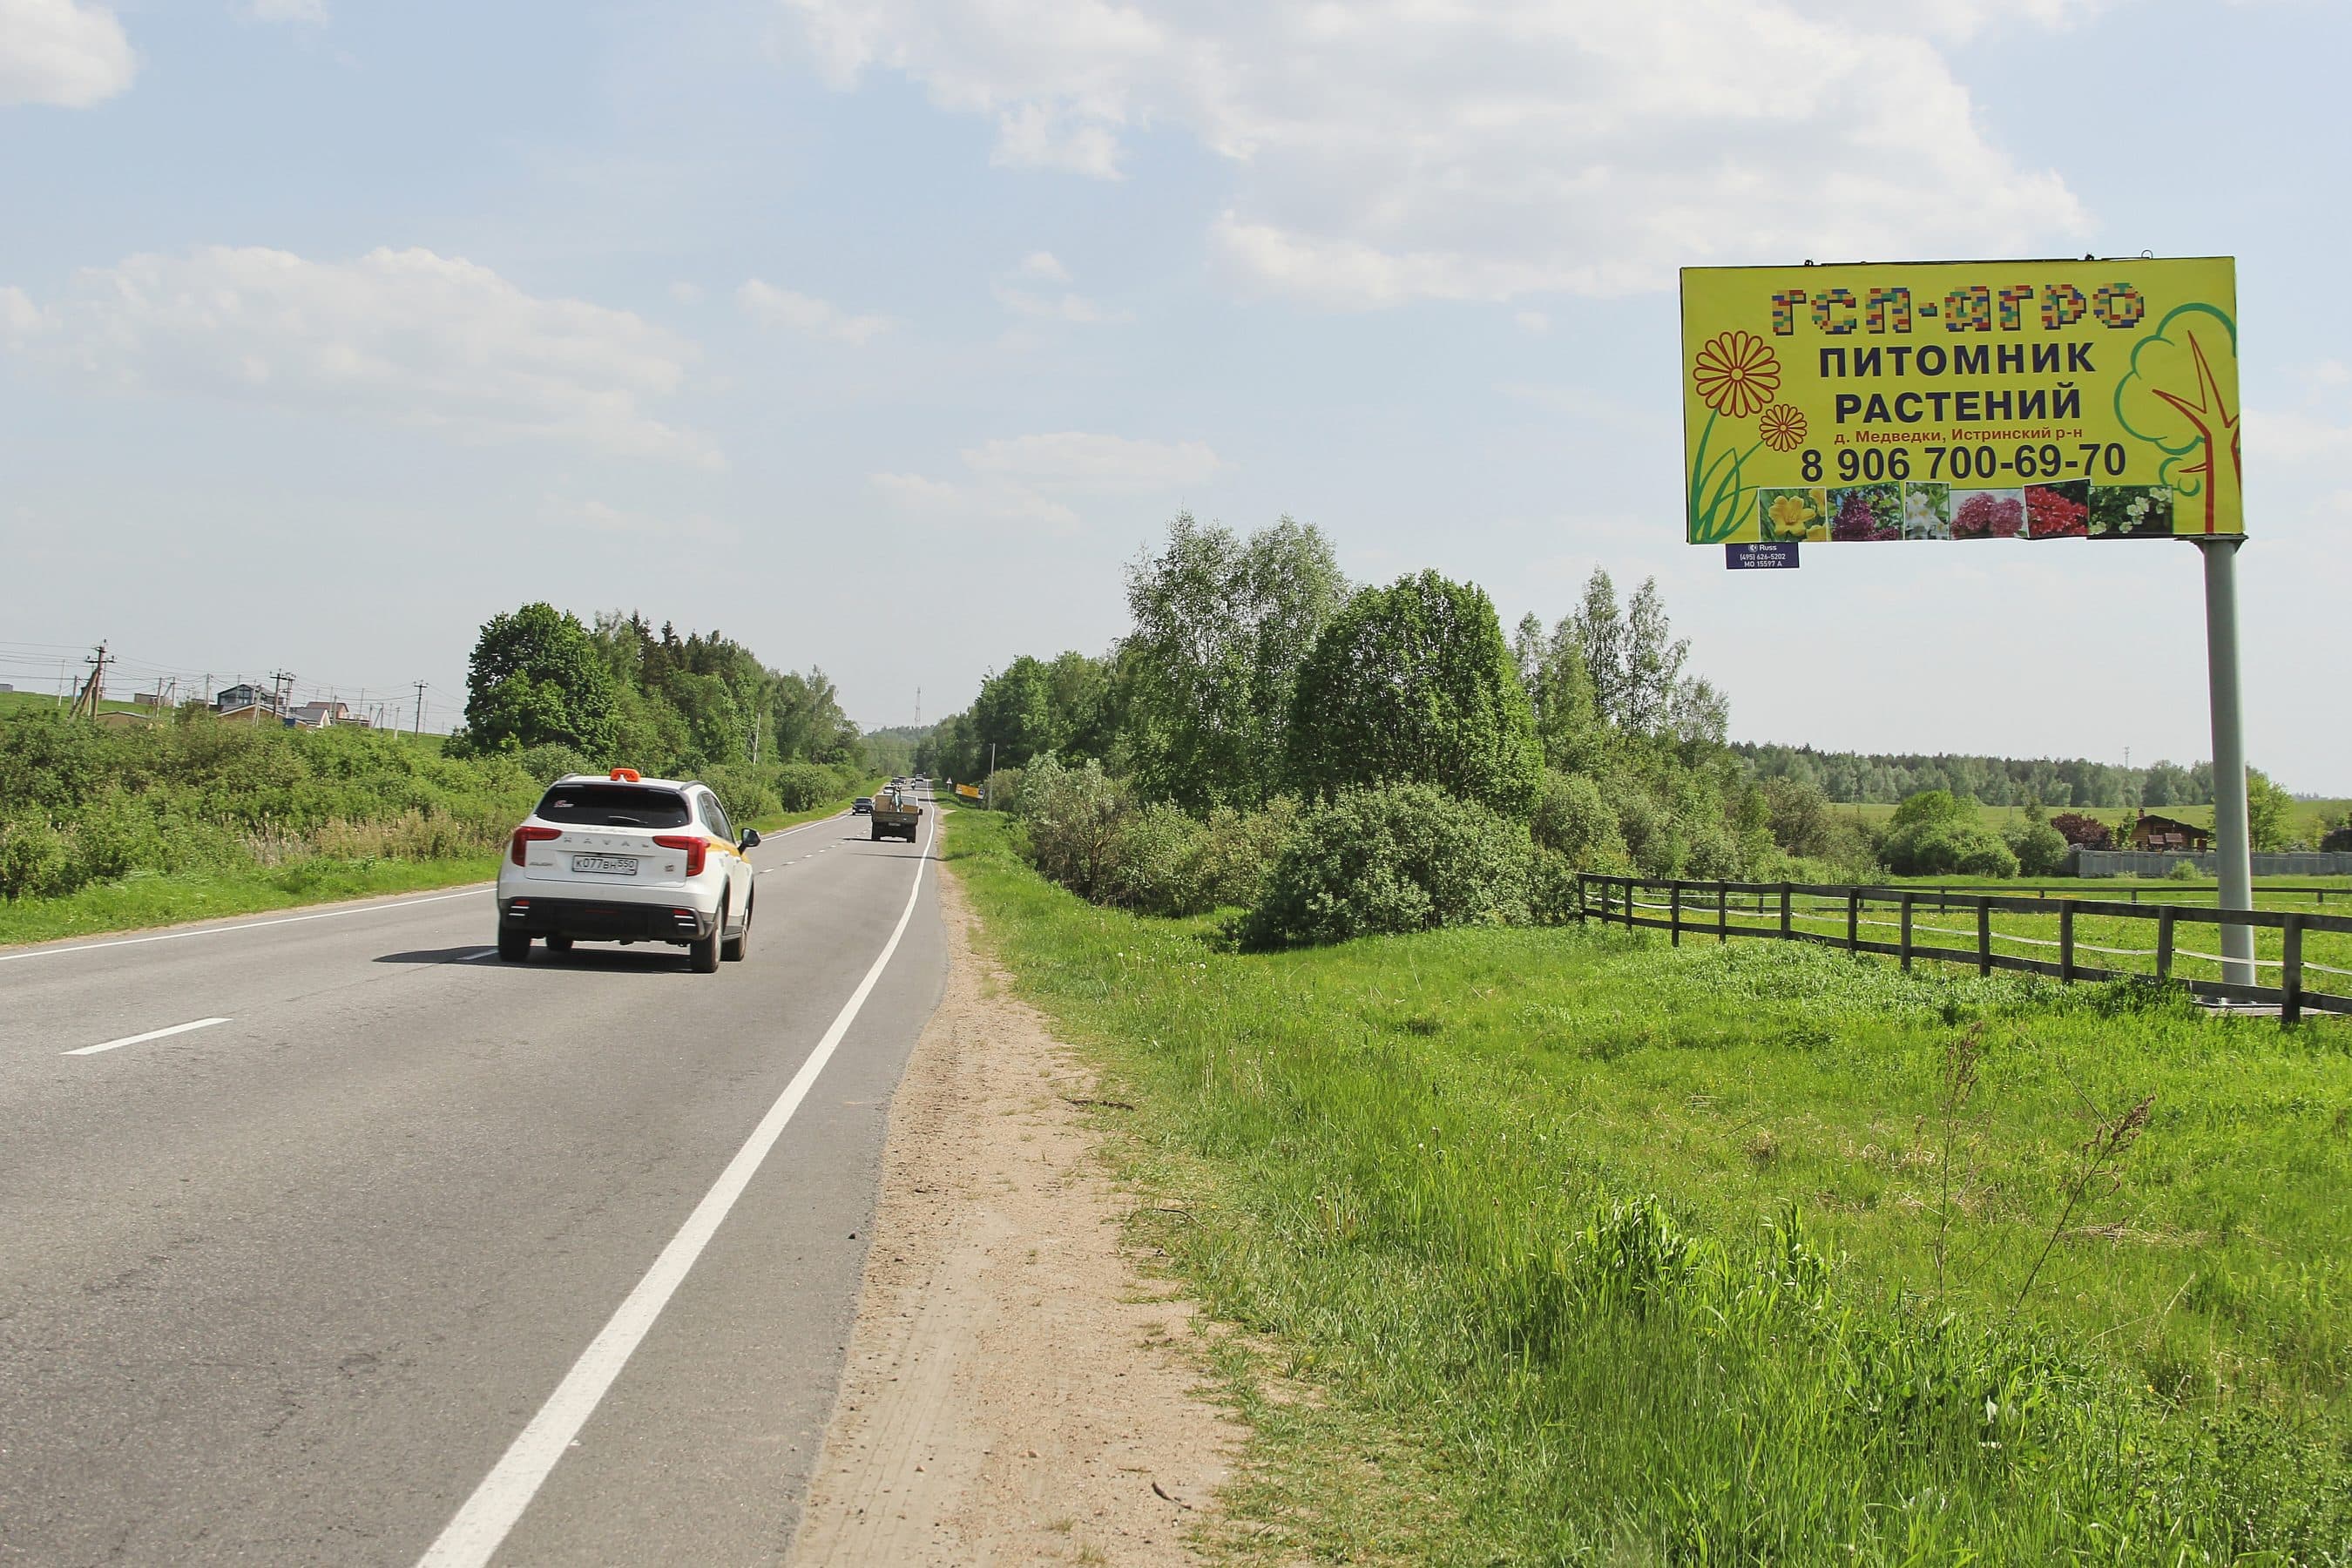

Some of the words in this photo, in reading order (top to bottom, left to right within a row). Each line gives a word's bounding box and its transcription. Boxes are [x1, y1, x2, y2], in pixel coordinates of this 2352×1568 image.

[1771, 283, 2145, 335] ГСП-АГРО
[1819, 341, 2097, 378] ПИТОМНИК
[1835, 382, 2081, 424] РАСТЕНИЙ
[1834, 435, 1850, 444] д.
[1855, 430, 1946, 443] Медведки,
[1951, 427, 2051, 442] Истринский
[2056, 429, 2083, 441] р-н
[1801, 449, 1823, 482] 8
[1837, 446, 1910, 481] 906
[1923, 443, 2126, 479] 700-69-70
